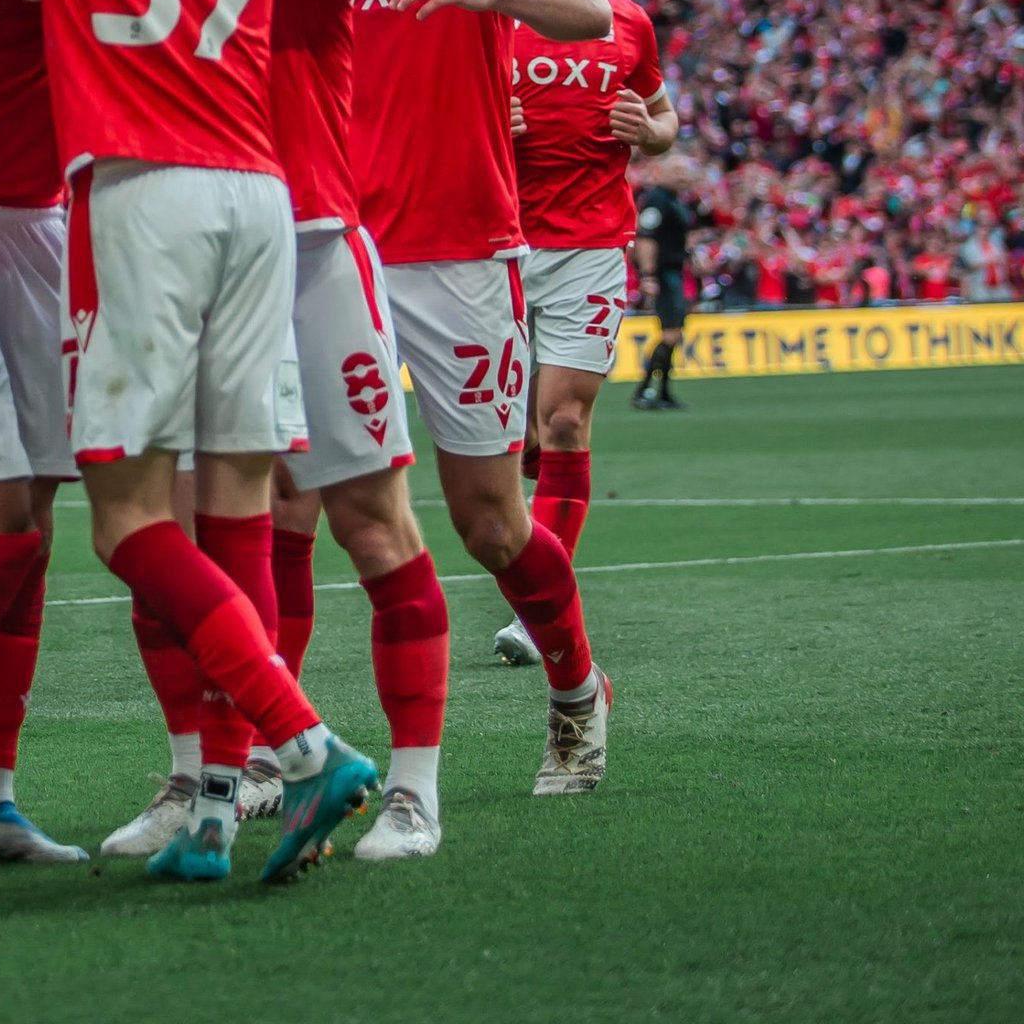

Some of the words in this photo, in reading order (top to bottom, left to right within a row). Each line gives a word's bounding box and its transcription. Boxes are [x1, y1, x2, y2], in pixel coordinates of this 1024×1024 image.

[453, 337, 523, 405] 26
[632, 329, 727, 373] TKE
[743, 327, 828, 369] TIME
[847, 325, 892, 363] TO
[905, 320, 1022, 362] THINK
[342, 351, 389, 415] 8
